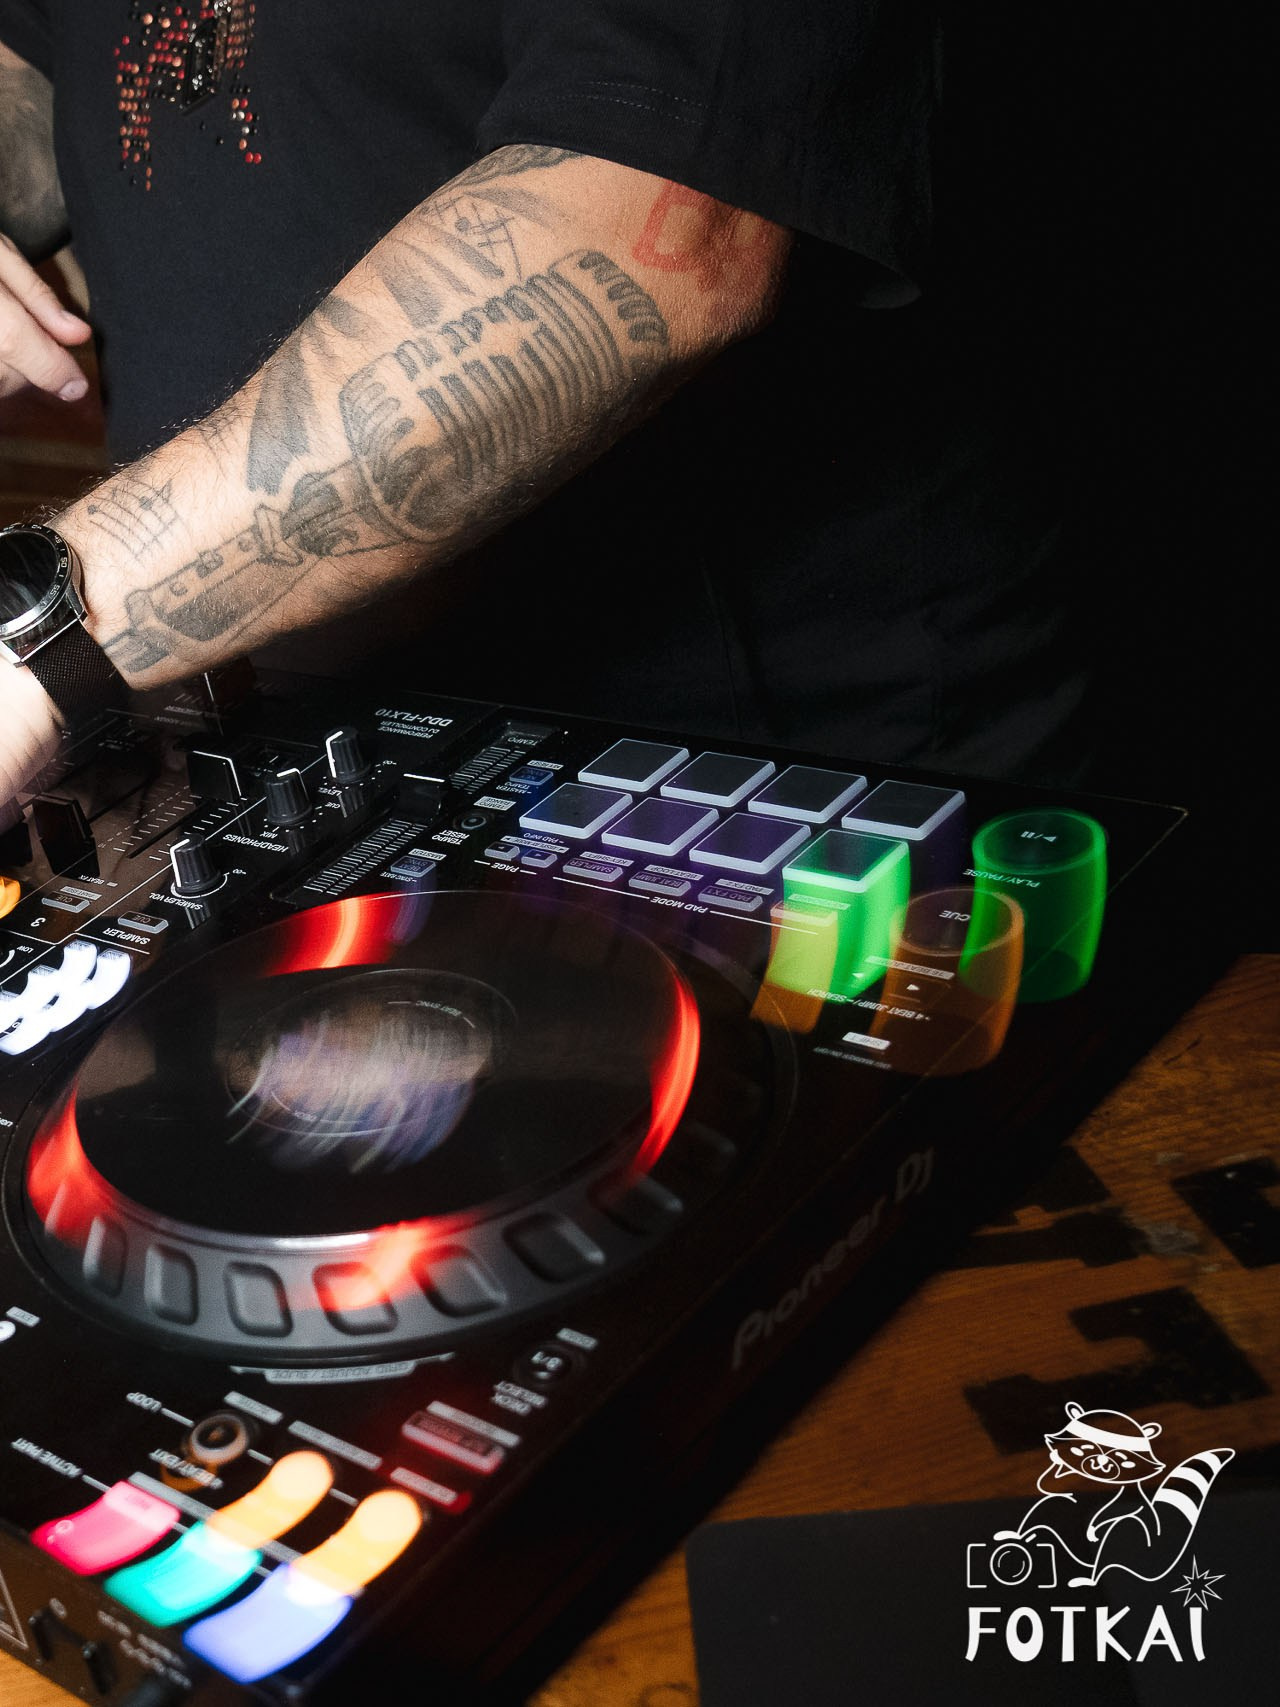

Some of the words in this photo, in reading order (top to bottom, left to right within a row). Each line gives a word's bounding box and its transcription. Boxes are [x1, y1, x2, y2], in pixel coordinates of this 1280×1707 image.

[60, 557, 68, 568] 50
[374, 707, 454, 727] DDJ-FLX10
[376, 726, 435, 739] PERFORMANCE
[380, 720, 430, 734] CONTROLLER
[507, 736, 539, 746] TEMPO
[325, 801, 341, 809] CUE
[259, 830, 279, 839] MIX
[431, 834, 463, 845] TEMPO
[439, 829, 471, 839] RESET
[523, 832, 542, 840] INFO
[542, 835, 560, 843] PAD
[222, 832, 289, 853] HEADPHONES
[490, 862, 520, 872] PAGE
[568, 859, 615, 873] SAMPLER
[962, 868, 1040, 888] PLAY/PAUSE
[148, 892, 167, 903] VOL
[165, 896, 204, 910] SAMPLER
[650, 896, 685, 908] MODE
[684, 903, 709, 913] PAD
[133, 914, 152, 925] CUE
[938, 910, 972, 921] CUE
[30, 917, 47, 928] 3
[102, 927, 151, 946] SAMPLER
[17, 946, 35, 954] LOW
[806, 988, 847, 1002] SEARCH
[887, 1005, 915, 1018] BEAT
[730, 1193, 888, 1371] Pioneer
[321, 1367, 369, 1379] ADJUST
[125, 1391, 163, 1413] LOOP
[10, 1437, 44, 1459] PART
[40, 1449, 83, 1479] ACTIVE
